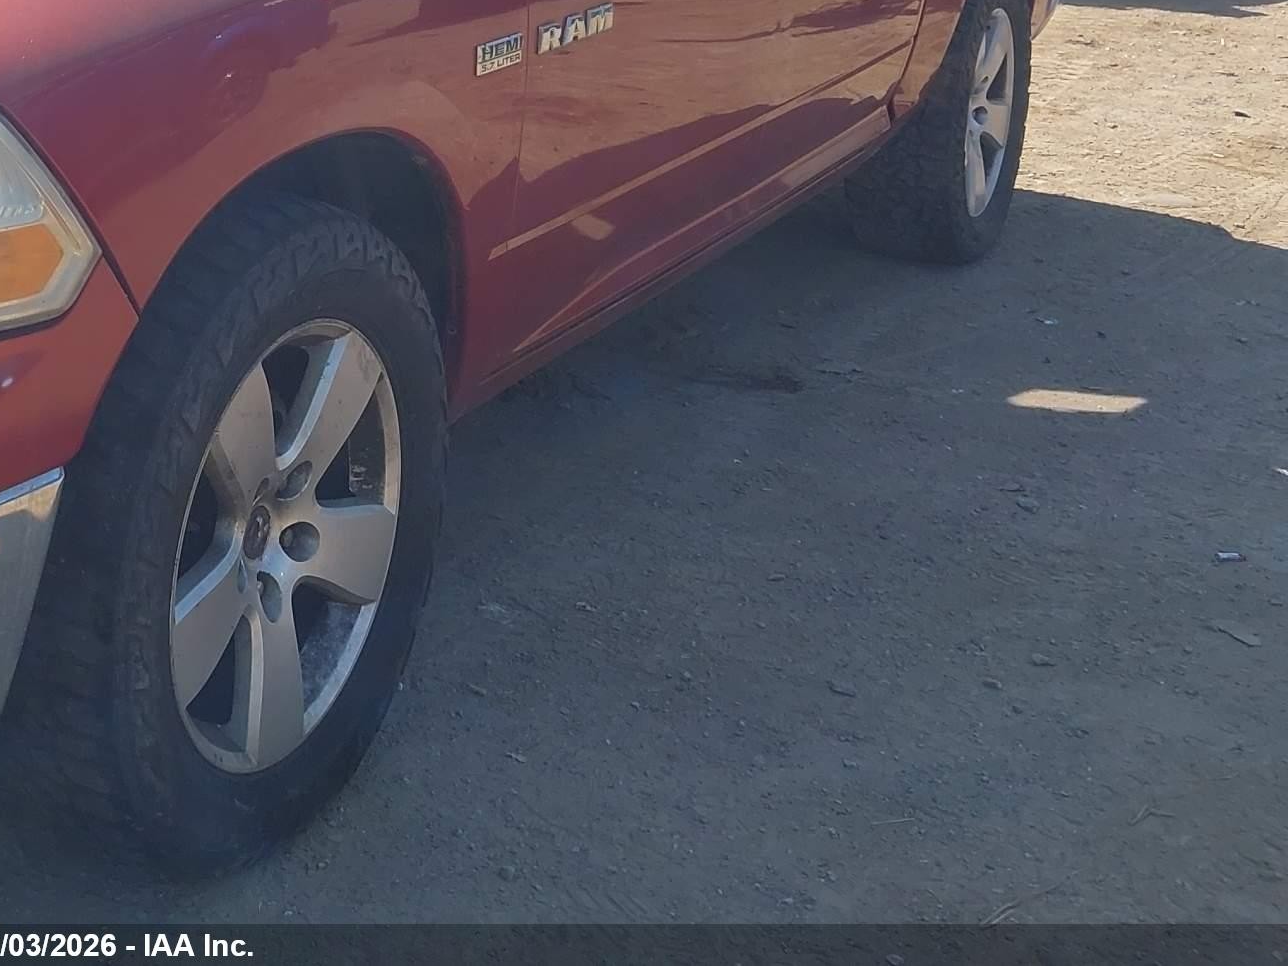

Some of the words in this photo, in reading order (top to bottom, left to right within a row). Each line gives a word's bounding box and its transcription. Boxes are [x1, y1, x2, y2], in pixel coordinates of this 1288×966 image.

[537, 3, 614, 54] RAM
[481, 34, 523, 61] HEMI
[481, 61, 495, 72] 5.7
[497, 53, 520, 67] LITER
